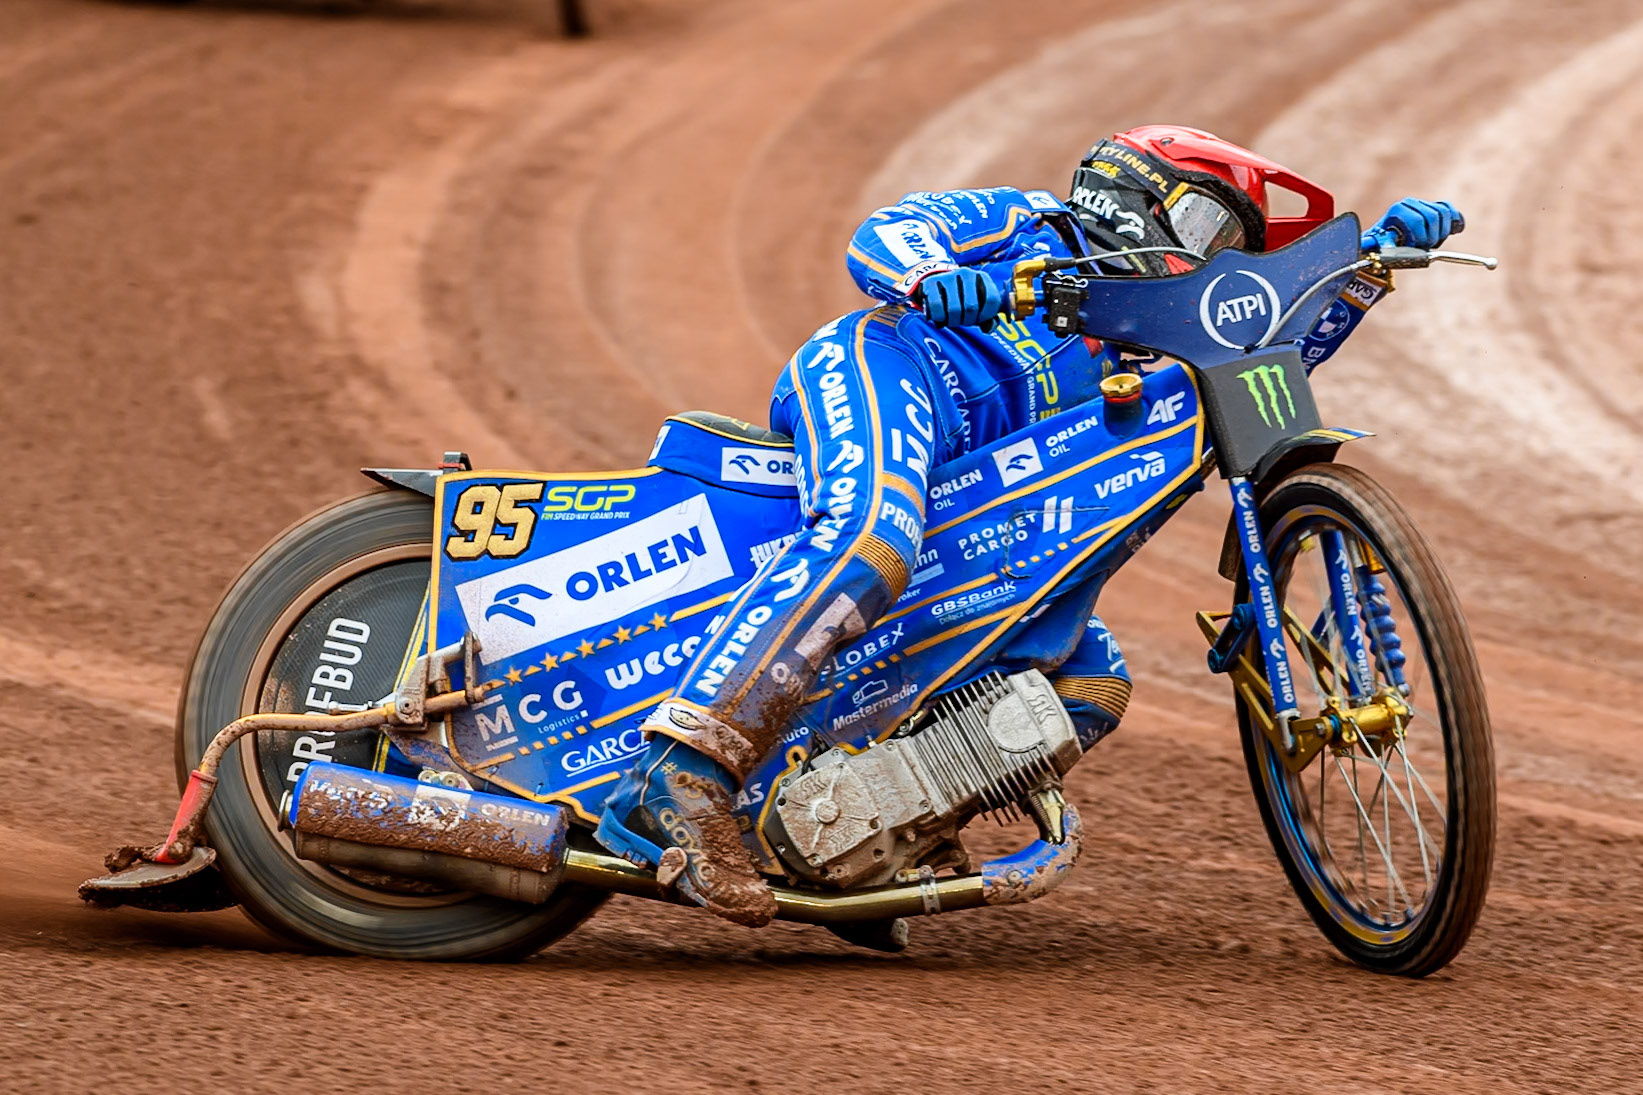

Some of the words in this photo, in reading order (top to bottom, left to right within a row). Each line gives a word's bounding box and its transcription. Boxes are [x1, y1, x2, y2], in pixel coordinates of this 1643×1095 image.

[1216, 293, 1266, 327] ATPI
[990, 331, 1034, 374] SPEEDWAY
[1026, 376, 1037, 411] GRAND
[996, 312, 1059, 405] SGP
[818, 371, 854, 441] ORLEN
[1045, 416, 1099, 447] ORLEN
[1049, 443, 1071, 458] OIL
[544, 484, 636, 511] SGP
[929, 469, 983, 499] ORLEN
[445, 481, 547, 562] 95
[541, 512, 554, 520] FIM
[553, 512, 589, 521] SPEEDWAY
[590, 512, 614, 520] GRAND
[613, 511, 631, 519] PRIX
[934, 498, 955, 511] OIL
[958, 513, 1036, 549] PROMET
[964, 529, 1028, 561] CARGO
[1243, 510, 1261, 553] ORLEN
[566, 525, 707, 601] ORLEN
[931, 580, 1017, 616] GBSBank
[1259, 585, 1278, 629] ORLEN
[695, 605, 772, 698] ORLEN
[1277, 660, 1294, 703] ORLEN
[474, 680, 583, 742] MCG
[537, 713, 580, 734] Logistics
[832, 684, 918, 731] Mastermedia
